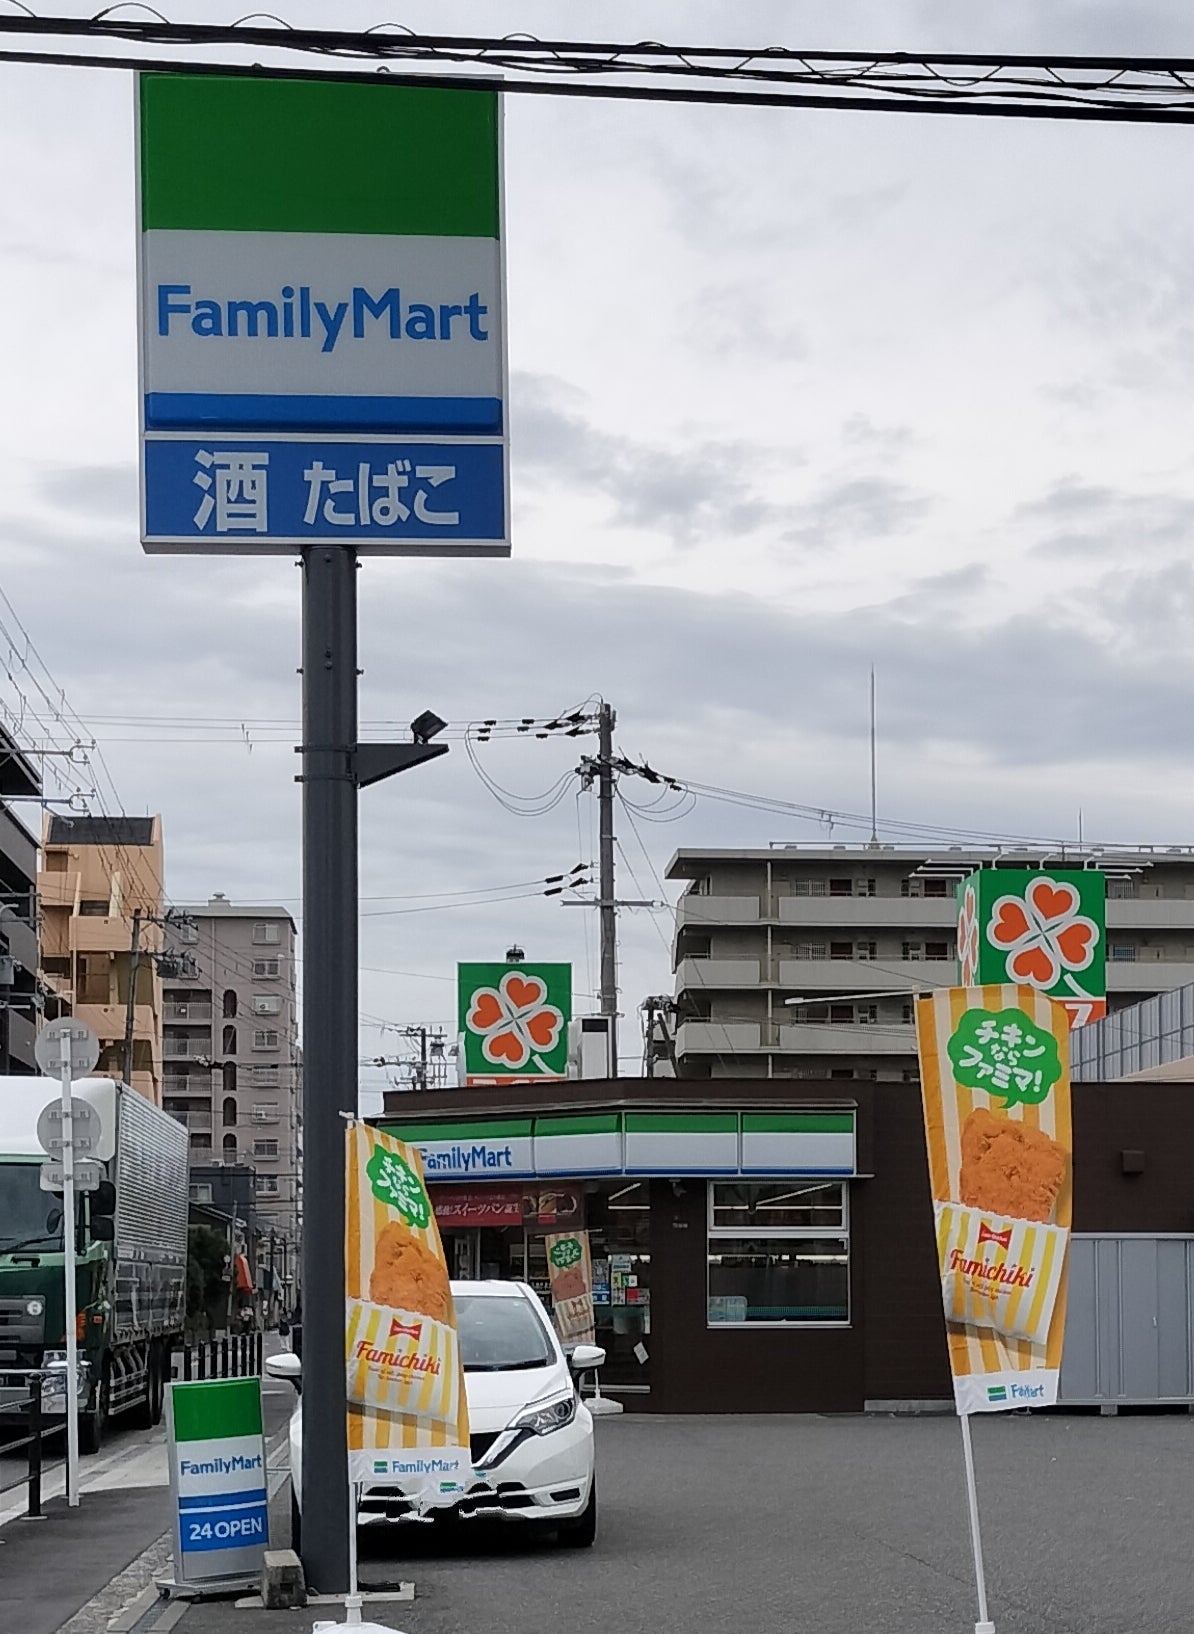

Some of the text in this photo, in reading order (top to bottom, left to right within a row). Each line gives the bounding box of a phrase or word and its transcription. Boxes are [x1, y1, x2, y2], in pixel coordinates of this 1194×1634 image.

[157, 285, 489, 352] FamilyMart
[192, 449, 460, 533] 酒 たばこ
[974, 1020, 1046, 1058] チキン
[991, 1043, 1021, 1066] なら
[950, 1248, 1035, 1288] Famichiki
[356, 1340, 441, 1376] Famichiki
[180, 1454, 262, 1476] FamilyMart
[392, 1459, 459, 1473] FamilyMart
